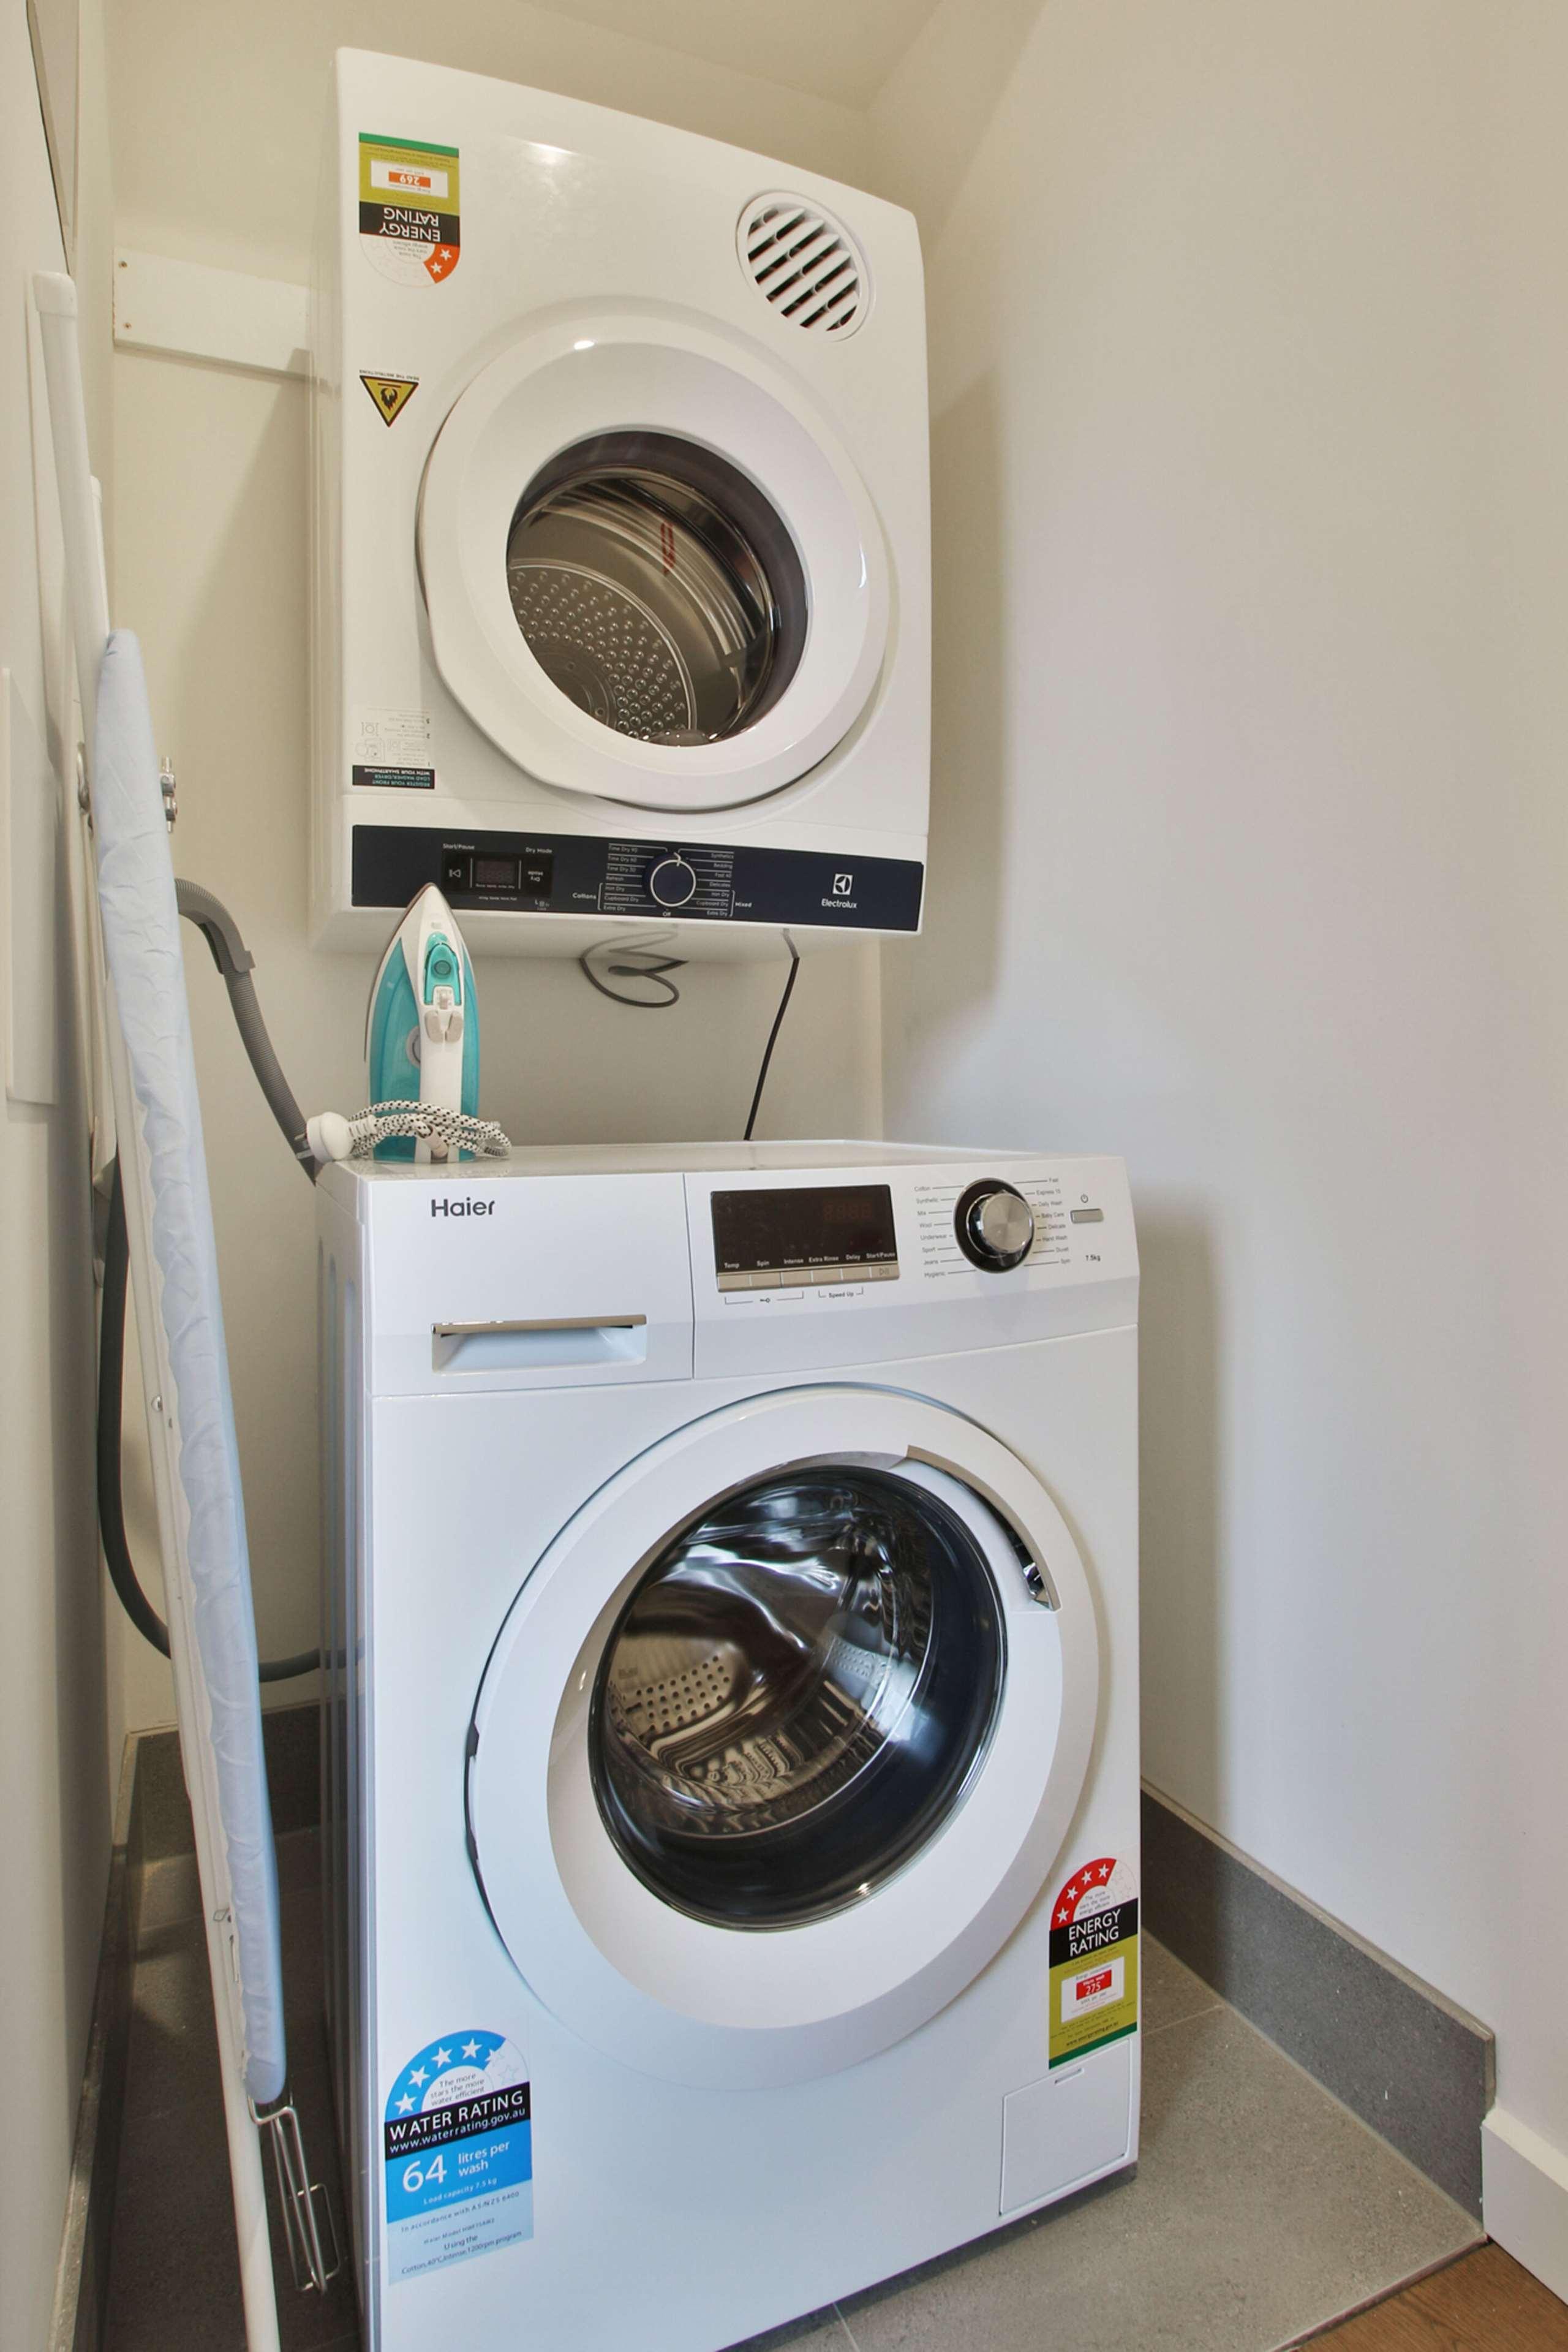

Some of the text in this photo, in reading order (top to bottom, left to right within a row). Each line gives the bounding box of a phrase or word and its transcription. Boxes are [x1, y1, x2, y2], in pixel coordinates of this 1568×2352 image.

[399, 175, 420, 185] 269
[383, 208, 439, 226] RATING
[379, 222, 441, 242] ENERGY
[821, 899, 858, 909] Electrolux
[431, 1197, 495, 1217] Haier
[1068, 1908, 1121, 1940] ENERGY
[1069, 1927, 1119, 1957] RATING
[1085, 1983, 1101, 1995] 275
[456, 2073, 476, 2082] more
[431, 2079, 484, 2098] stars the more
[431, 2086, 485, 2106] water efficient
[390, 2090, 524, 2141] WATER RATING
[390, 2108, 526, 2153] www.waterrating.gov.au
[458, 2141, 510, 2165] litres per
[402, 2154, 448, 2193] 64
[458, 2160, 489, 2177] wash
[423, 2193, 442, 2205] Load
[443, 2185, 474, 2199] capacity
[487, 2177, 497, 2186] kg
[454, 2206, 470, 2217] with
[444, 2234, 478, 2250] Using the
